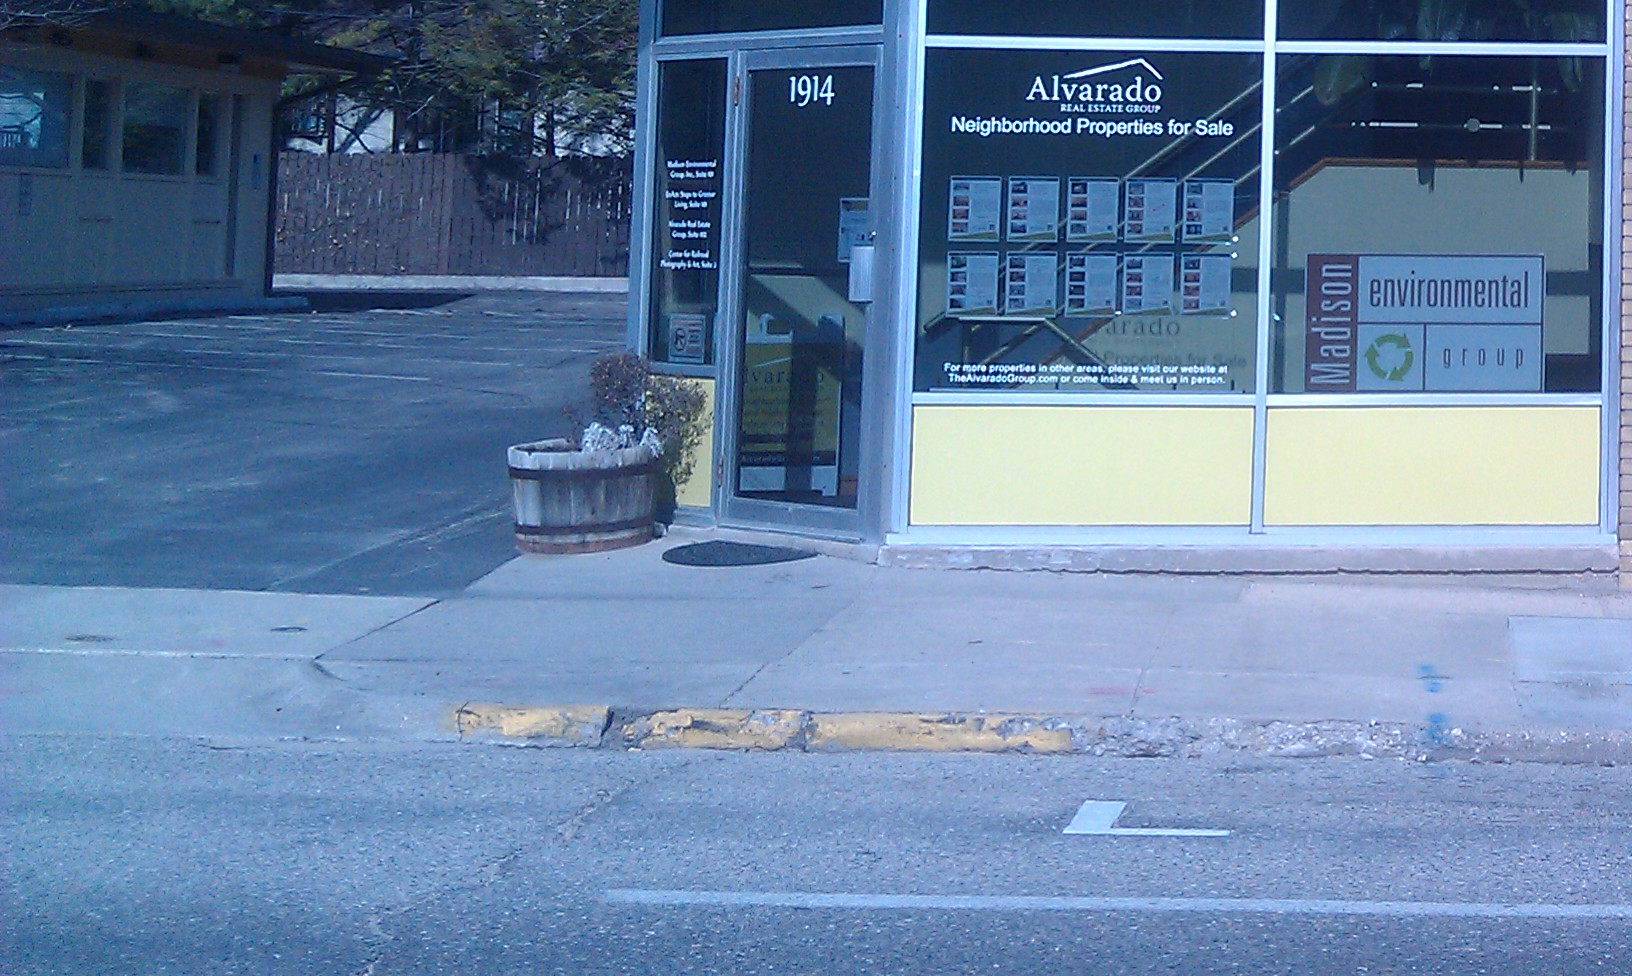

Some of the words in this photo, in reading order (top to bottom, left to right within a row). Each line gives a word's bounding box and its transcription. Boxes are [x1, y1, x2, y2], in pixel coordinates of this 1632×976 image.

[789, 74, 835, 107] 1914
[1025, 74, 1162, 102] Alvarado
[1060, 104, 1086, 112] REAL
[1088, 104, 1124, 113] ESTATE
[1125, 104, 1161, 113] GROUP
[951, 116, 1072, 137] Neighborhood
[1076, 117, 1164, 138] Properties
[1167, 119, 1191, 135] for
[1195, 119, 1234, 136] Sale
[1369, 270, 1529, 308] environmental
[1309, 263, 1352, 385] Madison
[944, 362, 961, 372] For
[963, 363, 987, 372] more
[988, 363, 1037, 374] properties
[1039, 364, 1048, 373] in
[1049, 364, 1074, 373] other
[1108, 364, 1140, 374] please
[1140, 364, 1161, 374] visit
[1162, 366, 1178, 374] our
[1180, 365, 1217, 374] website
[1218, 365, 1229, 374] at
[1443, 347, 1524, 369] group
[948, 373, 1059, 384] TheAlvaradoGroup.com
[1061, 375, 1072, 383] or
[1072, 375, 1099, 383] come
[1100, 374, 1129, 383] inside
[1130, 374, 1138, 383] &
[1140, 374, 1164, 383] meet
[1166, 375, 1178, 384] us
[1180, 374, 1189, 383] in
[1190, 375, 1226, 385] person.
